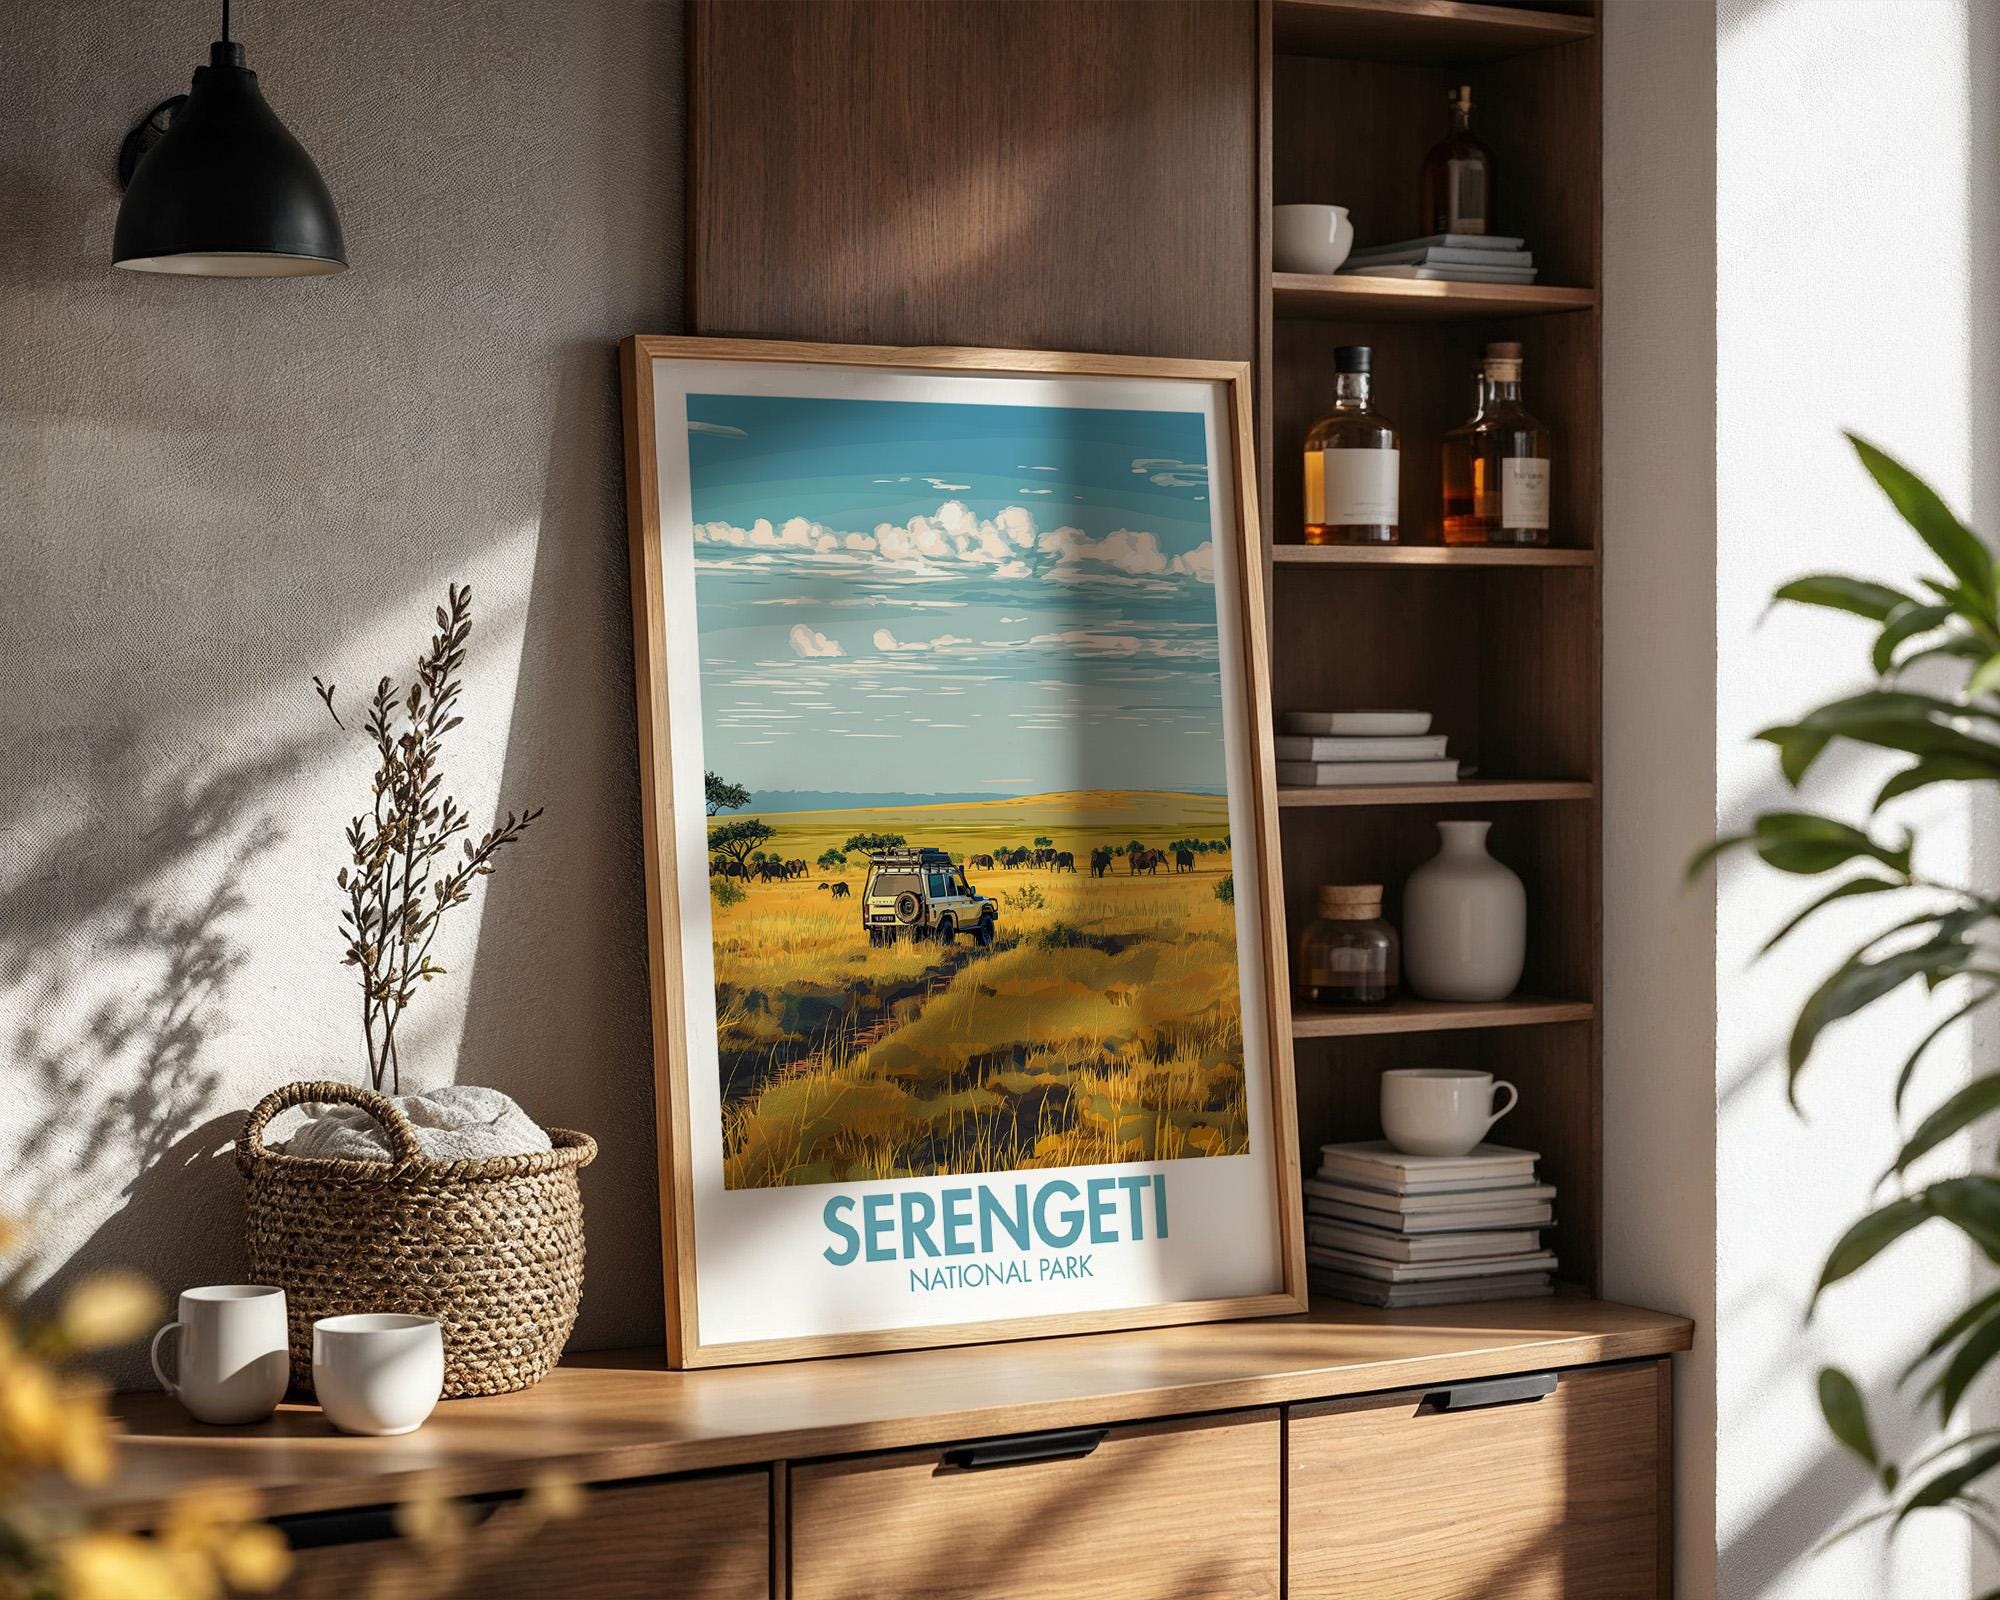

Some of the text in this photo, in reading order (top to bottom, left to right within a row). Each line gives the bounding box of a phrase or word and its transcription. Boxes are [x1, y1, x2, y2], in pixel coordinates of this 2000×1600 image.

[823, 1174, 1168, 1266] SERENGETI
[910, 1254, 1094, 1292] NATIONAL PARK
